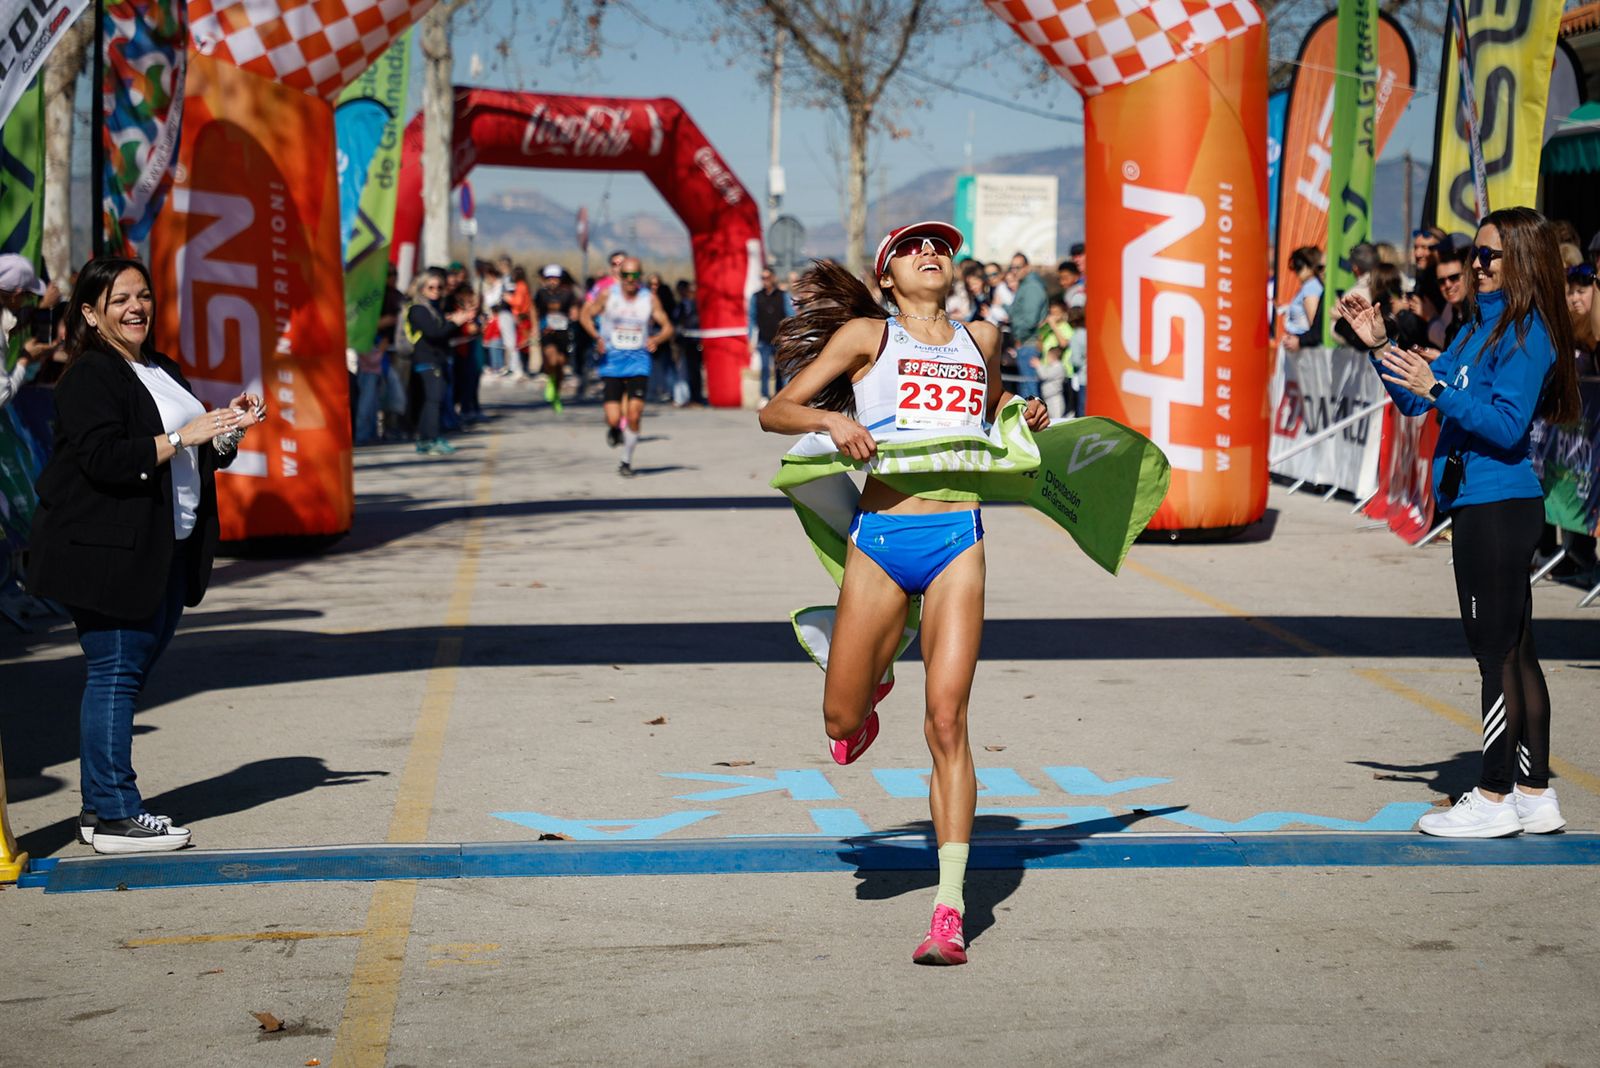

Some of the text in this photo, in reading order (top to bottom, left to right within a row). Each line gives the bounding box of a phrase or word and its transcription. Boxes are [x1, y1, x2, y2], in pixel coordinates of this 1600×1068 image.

[375, 158, 394, 189] de
[269, 180, 298, 478] WE ARE NUTRITION!
[1120, 183, 1206, 472] HSN
[1216, 182, 1233, 472] WE ARE NUTRITION!
[914, 344, 959, 353] MARACENA
[920, 366, 969, 379] FONDO
[899, 382, 984, 416] 2325
[1046, 469, 1081, 508] Diputación
